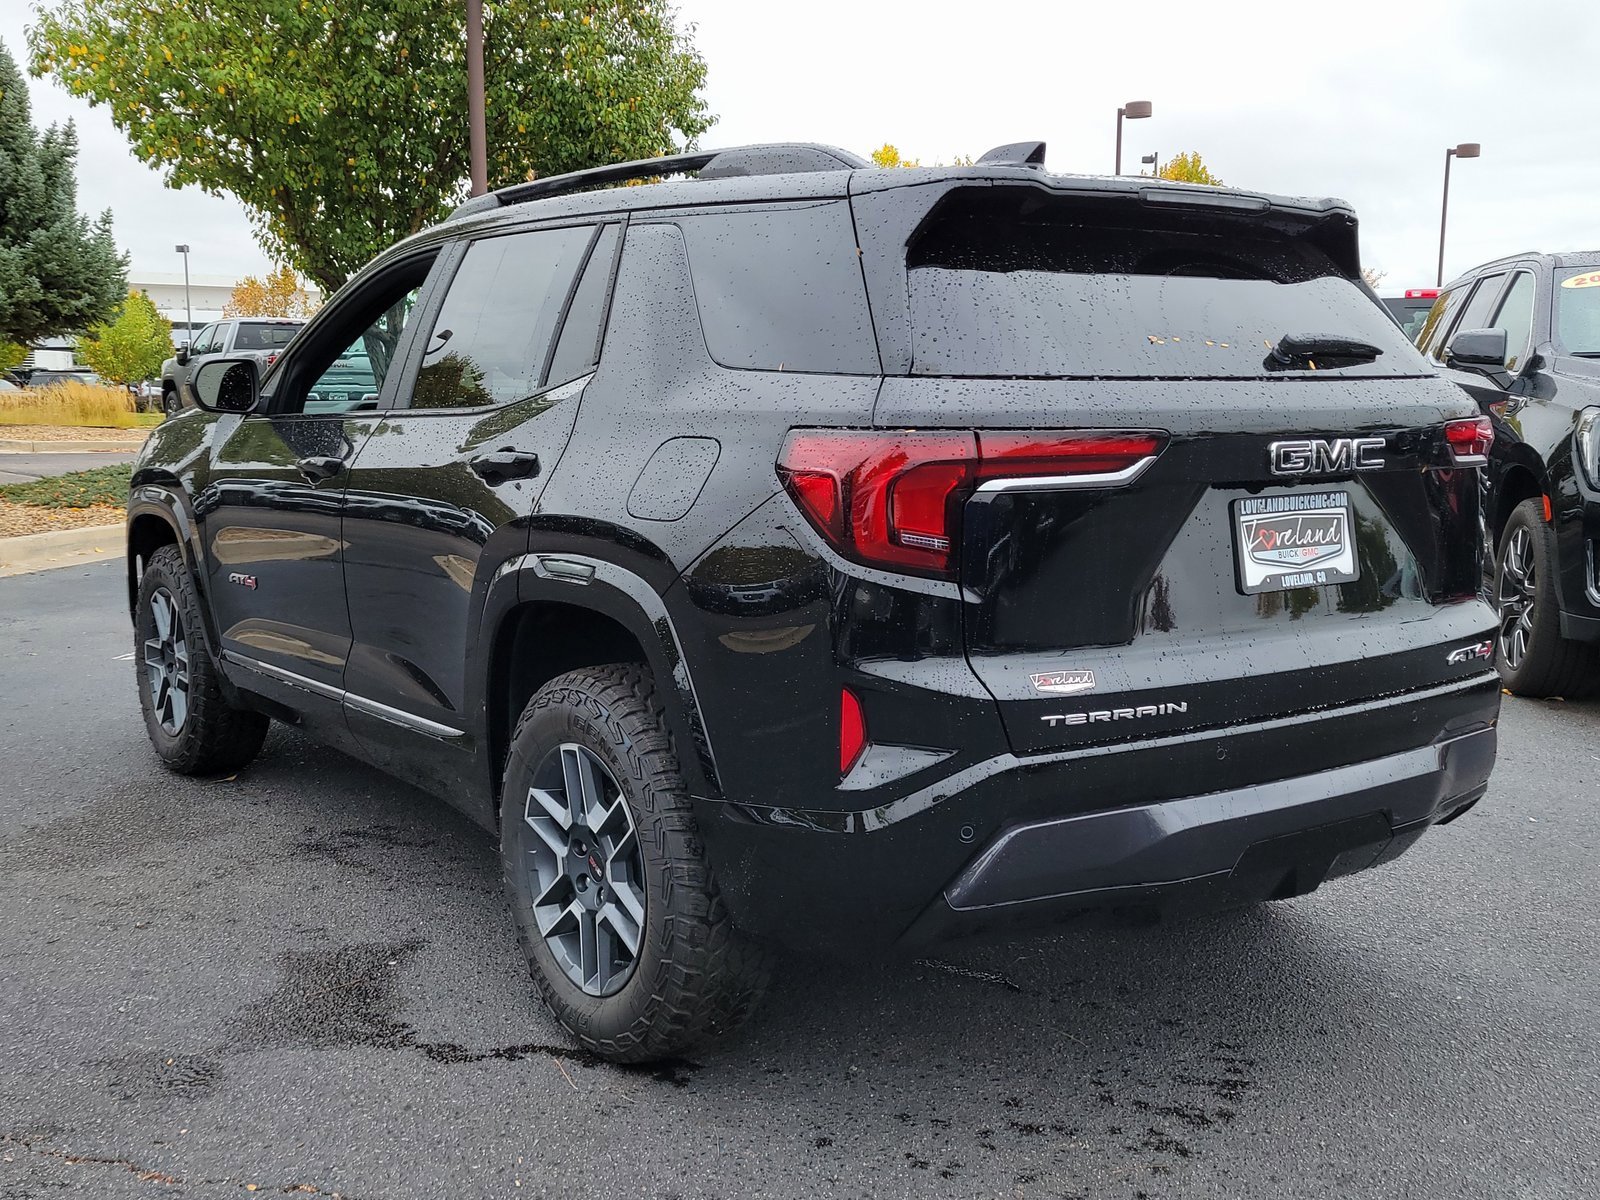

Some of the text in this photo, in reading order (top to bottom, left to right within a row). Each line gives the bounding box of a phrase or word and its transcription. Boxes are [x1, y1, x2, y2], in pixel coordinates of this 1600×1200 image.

[1269, 437, 1386, 475] GMC
[1240, 492, 1348, 515] LOVELANDBUICKGMC.COM
[1278, 547, 1319, 559] BUICK GMC
[229, 572, 257, 590] AT4
[1317, 570, 1327, 582] CO
[1446, 640, 1492, 666] AT4
[1040, 702, 1188, 727] TERRAIN
